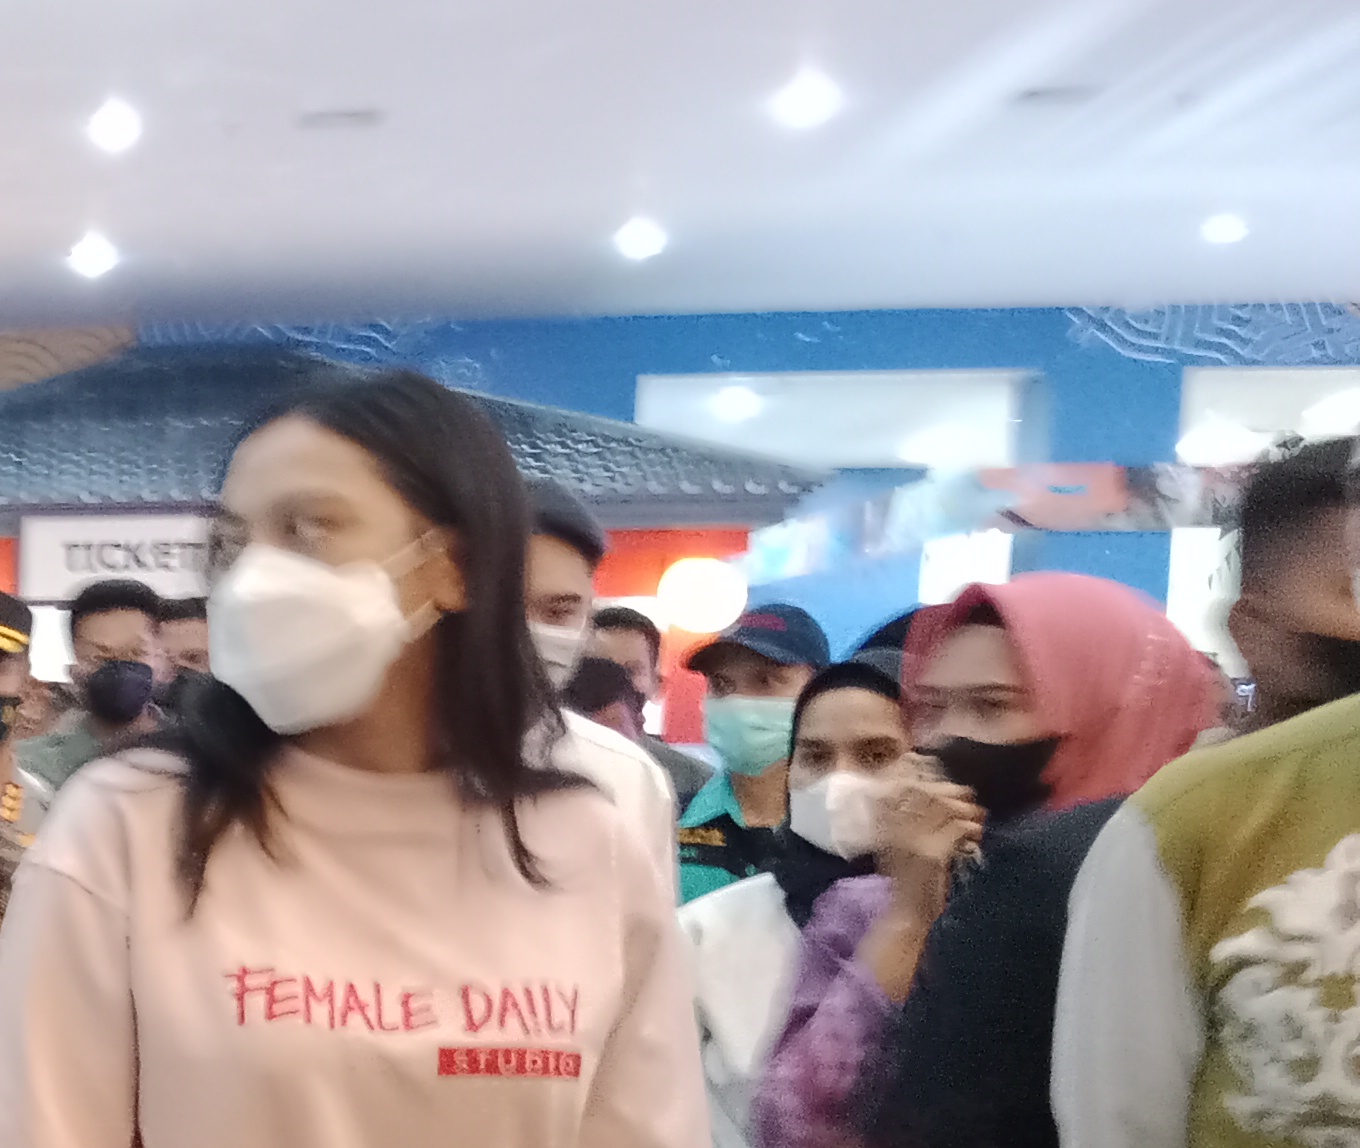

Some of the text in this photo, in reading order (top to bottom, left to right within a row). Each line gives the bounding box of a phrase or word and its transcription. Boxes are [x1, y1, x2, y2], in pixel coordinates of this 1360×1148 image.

[223, 966, 579, 1037] FEMALE DAILY
[452, 1048, 579, 1078] STUDIO
